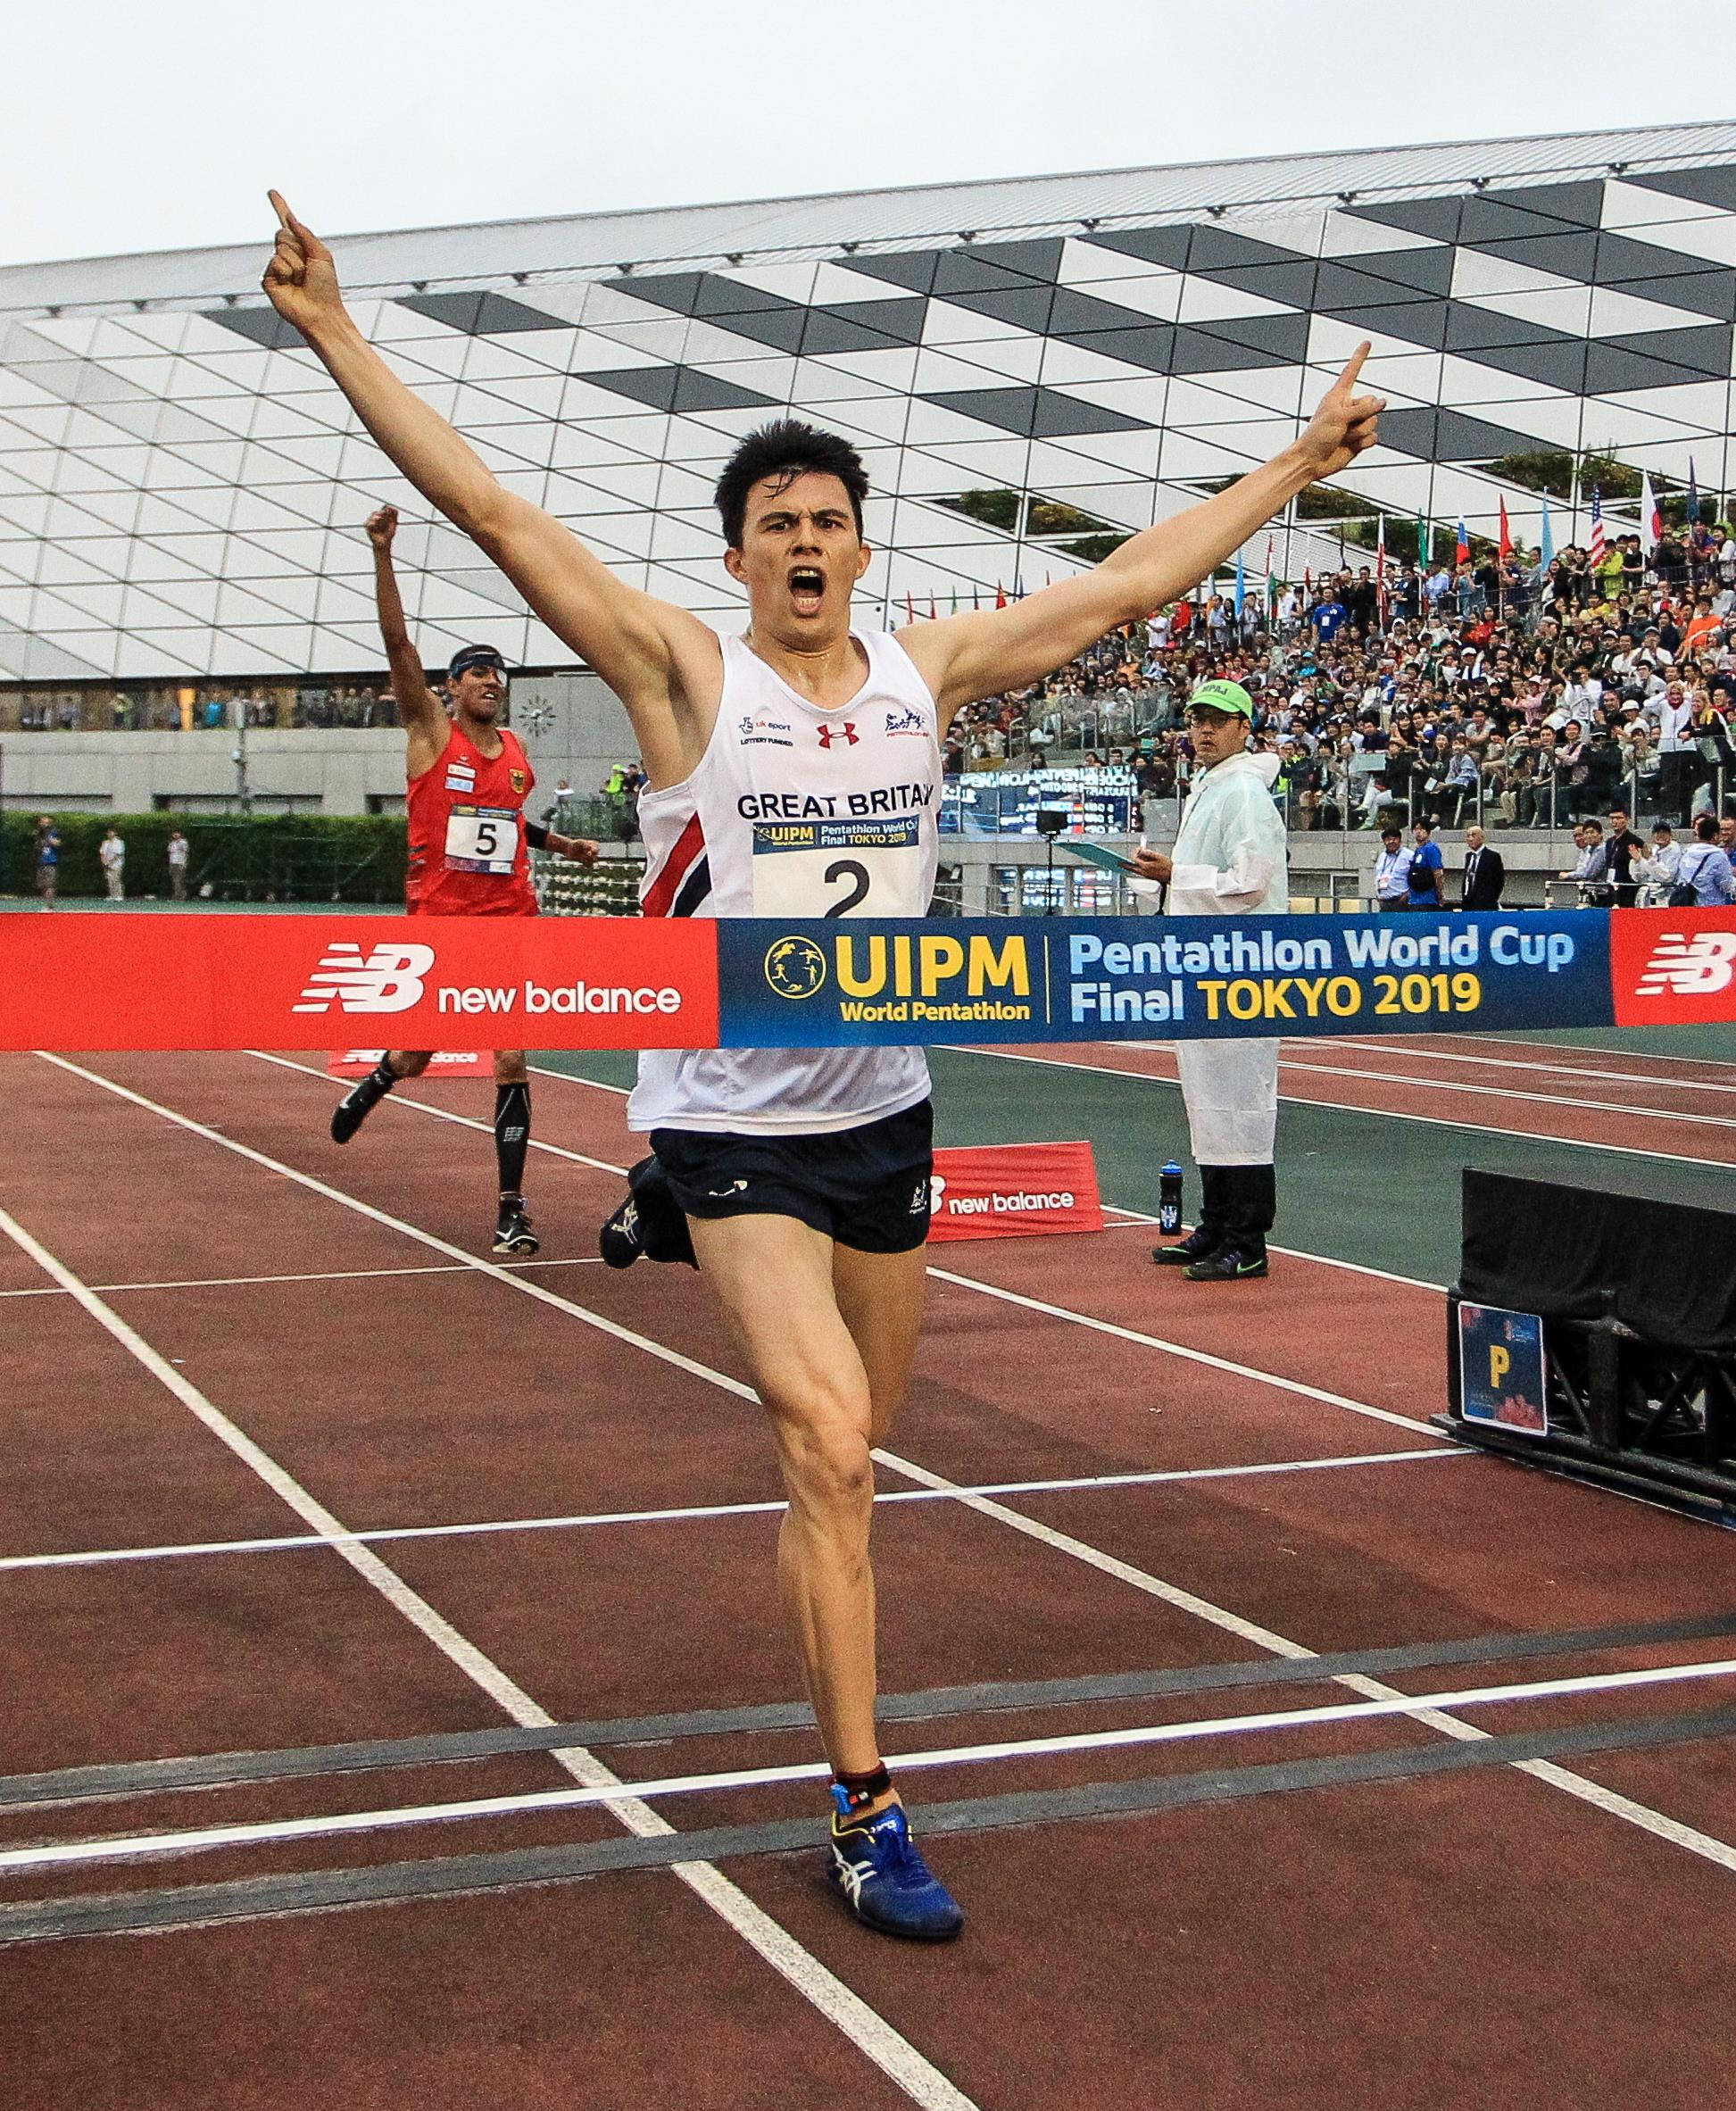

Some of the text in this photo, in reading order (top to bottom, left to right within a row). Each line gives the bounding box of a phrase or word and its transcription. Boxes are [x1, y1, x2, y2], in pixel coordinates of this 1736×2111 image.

[768, 722, 791, 732] sport
[737, 794, 837, 819] GREAT
[475, 823, 497, 855] 5
[771, 827, 814, 841] UIPM
[820, 835, 845, 844] Final
[848, 834, 885, 844] TOKYO
[821, 824, 881, 835] Pentathlon
[824, 860, 870, 918] 2
[1070, 924, 1574, 974] Pentathlon World Cup
[835, 935, 1031, 998] UIPM
[438, 980, 681, 1014] new balance
[1071, 972, 1482, 1023] Final TOKYO 2019
[839, 1001, 1030, 1023] World Pentathlon
[948, 1197, 990, 1215] new
[993, 1190, 1075, 1212] balance
[1490, 1344, 1510, 1389] P
